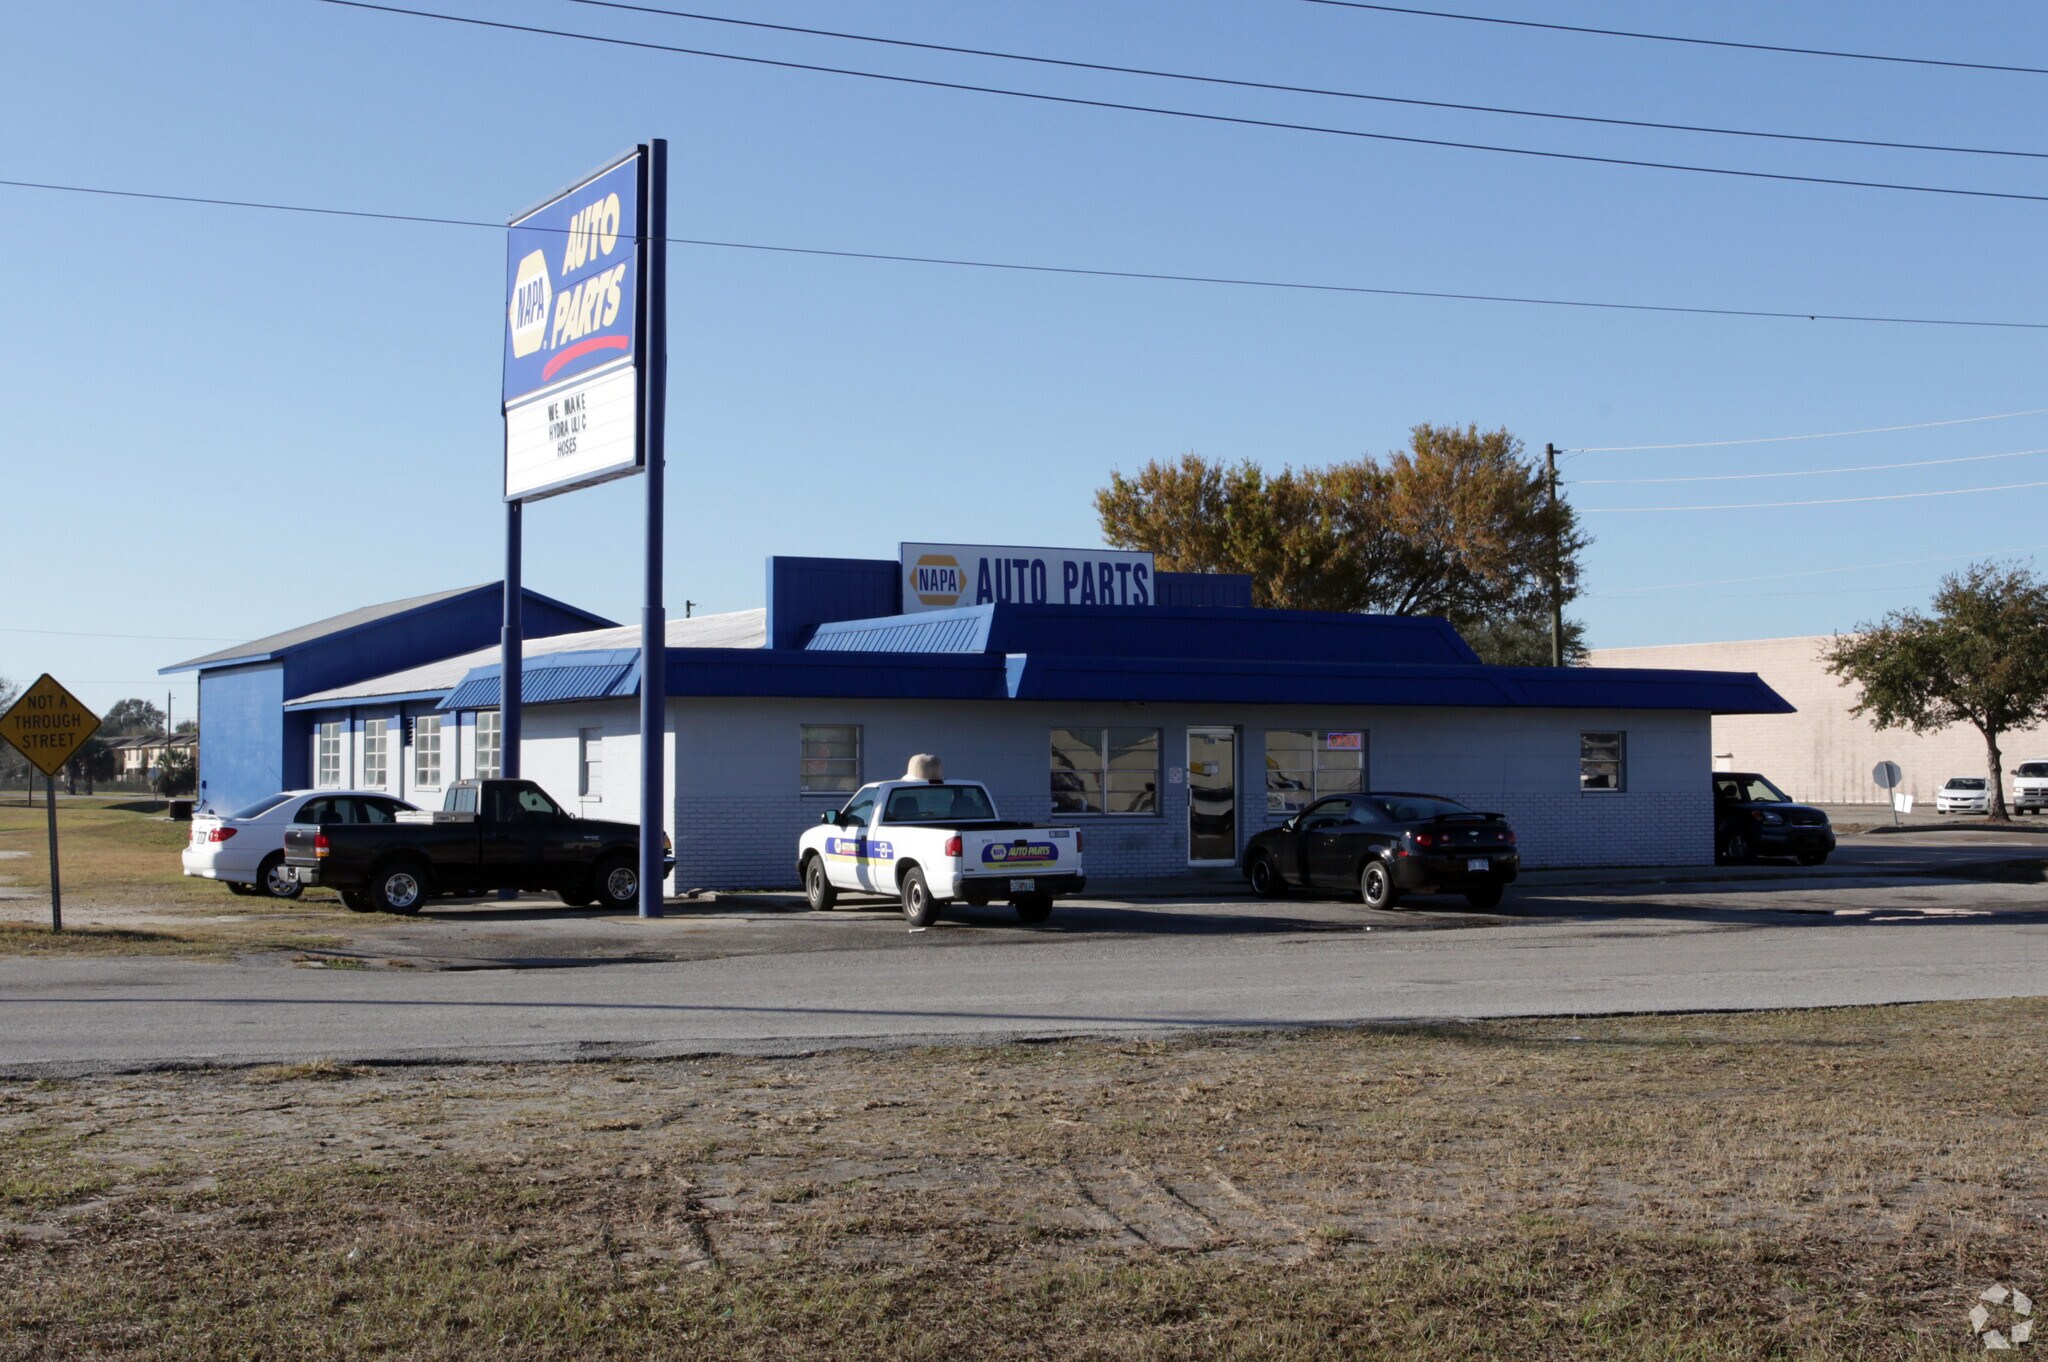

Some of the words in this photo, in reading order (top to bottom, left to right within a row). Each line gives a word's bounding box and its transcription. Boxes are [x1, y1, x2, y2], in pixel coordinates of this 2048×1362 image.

[562, 193, 620, 276] AUTO
[516, 277, 544, 330] NAPA
[551, 263, 625, 350] PARTS
[548, 403, 559, 422] WE
[564, 393, 586, 416] MAKE
[557, 437, 577, 458] HOSES
[919, 568, 957, 592] NAPA
[976, 558, 1047, 606] AUTO
[1063, 561, 1149, 606] PARTS
[27, 695, 54, 710] NOT
[59, 695, 68, 709] A
[14, 713, 81, 729] THROUGH
[22, 733, 75, 749] STREET
[1330, 735, 1359, 747] OPEN
[1008, 847, 1027, 856] AUTO
[1028, 846, 1050, 856] PARTS
